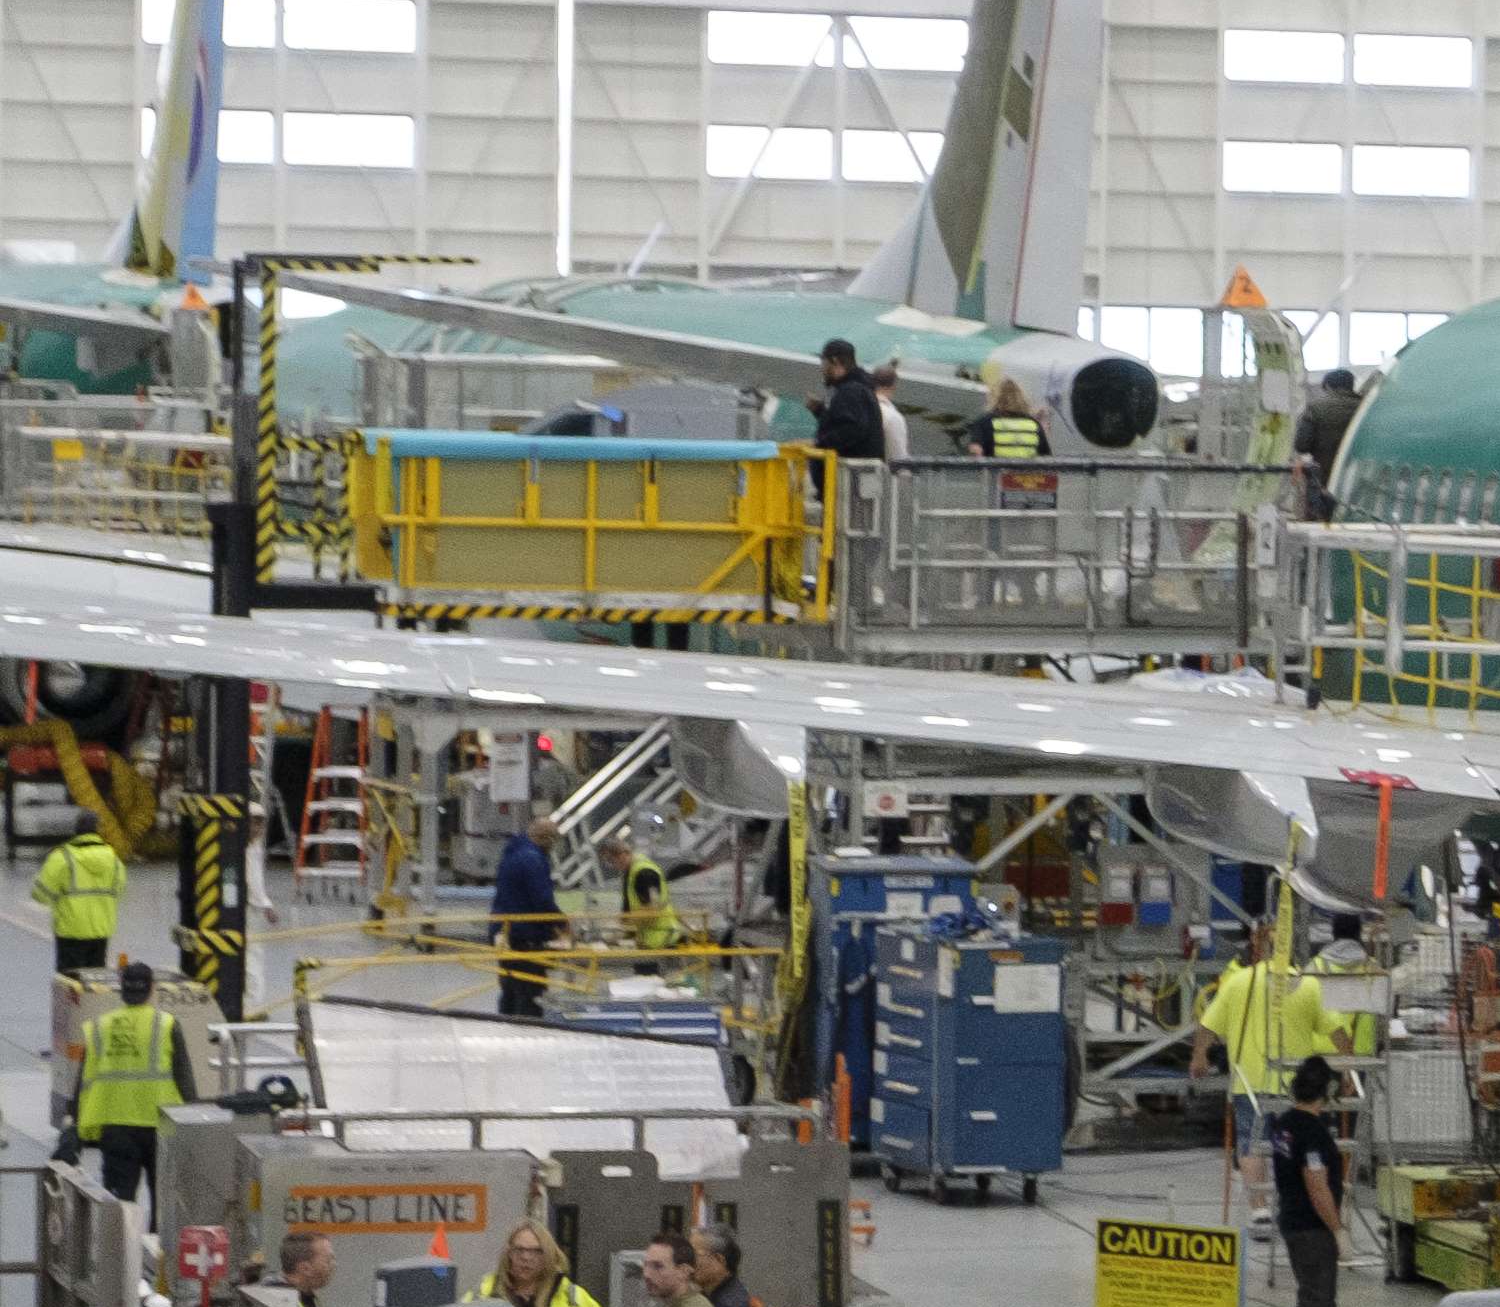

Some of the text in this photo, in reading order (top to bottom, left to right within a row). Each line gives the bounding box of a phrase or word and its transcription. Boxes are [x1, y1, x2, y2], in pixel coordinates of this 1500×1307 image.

[1239, 275, 1253, 294] 2
[394, 1194, 467, 1223] LINE
[1102, 1224, 1233, 1264] CAUTION
